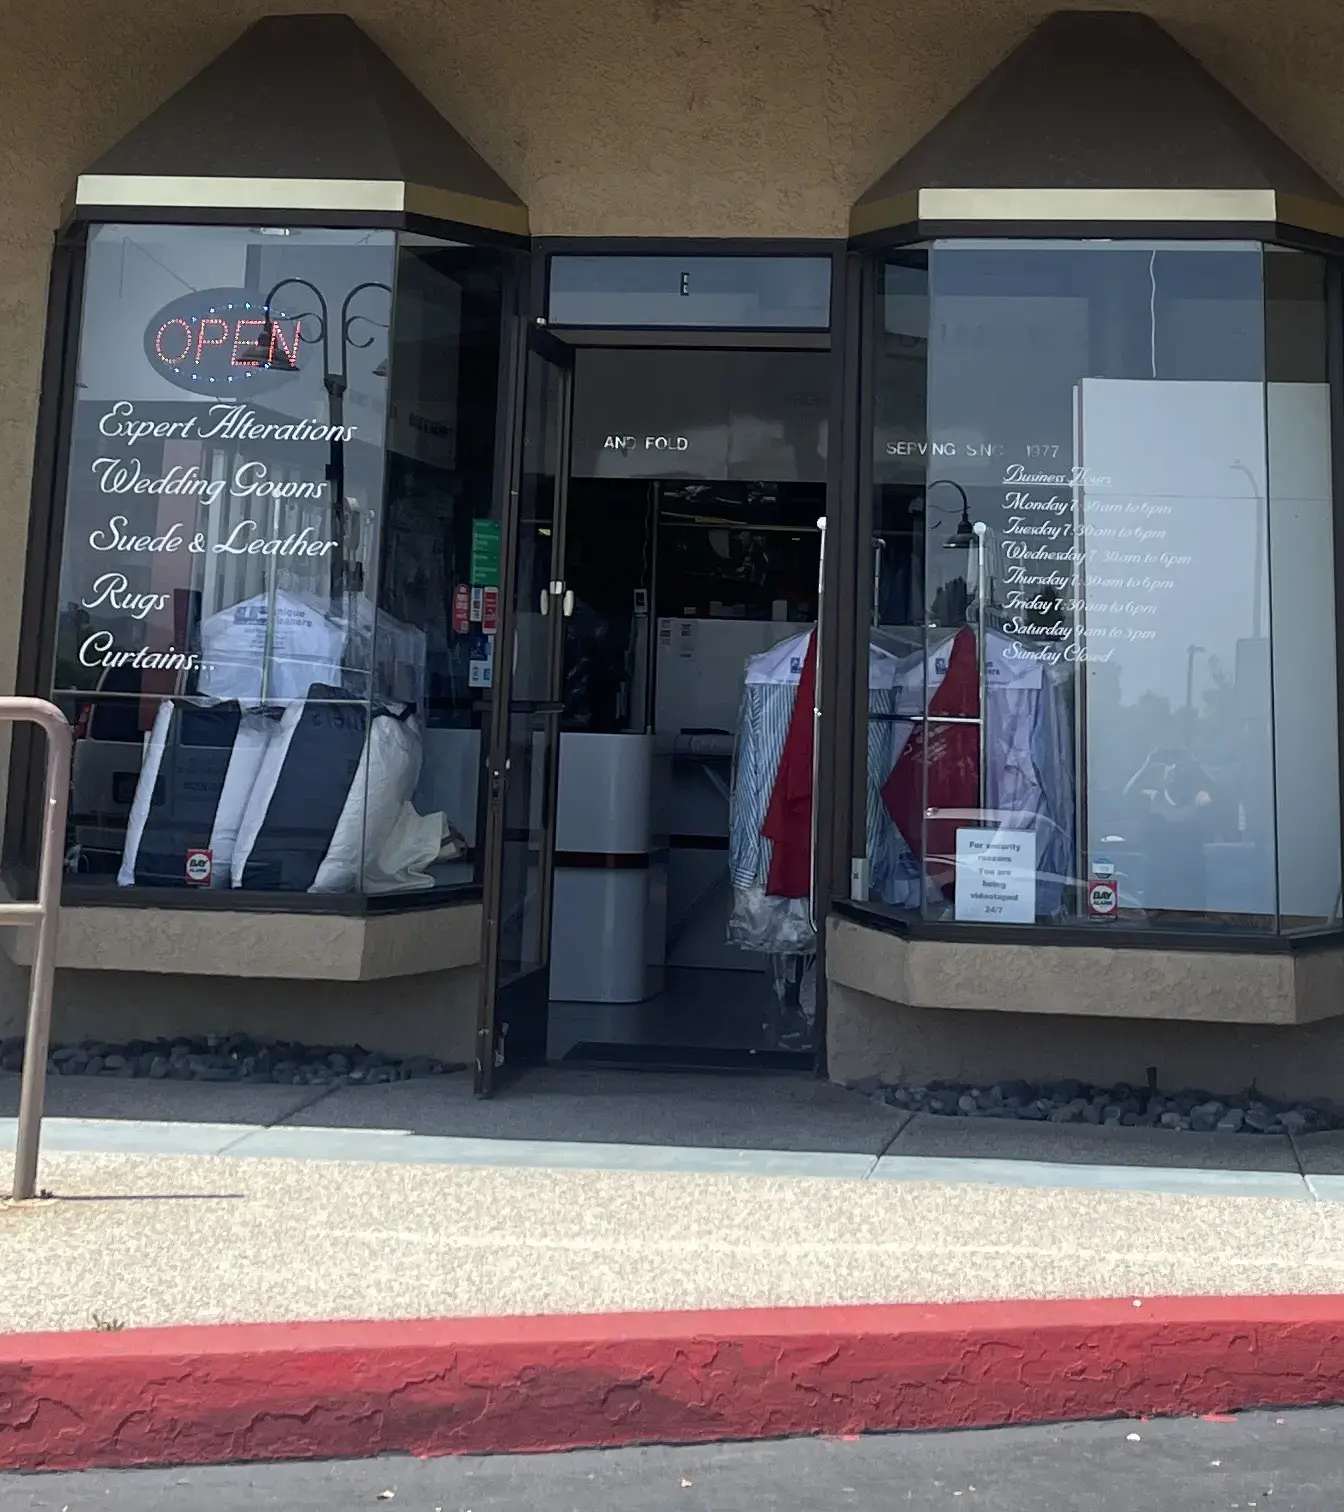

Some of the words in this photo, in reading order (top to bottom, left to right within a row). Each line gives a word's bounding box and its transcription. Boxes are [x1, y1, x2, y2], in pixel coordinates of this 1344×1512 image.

[156, 318, 302, 368] OPEN
[98, 401, 199, 446] Expert
[197, 404, 358, 442] Alterations
[603, 435, 636, 449] AND
[645, 436, 689, 450] FOLD
[1025, 444, 1061, 458] 1977
[91, 457, 227, 505] Wedding
[229, 461, 328, 499] Gowns
[1002, 464, 1067, 484] Business
[1001, 491, 1069, 516] Monday
[89, 515, 185, 552] Suede
[188, 532, 206, 553] &
[212, 520, 339, 556] Leather
[1002, 516, 1062, 540] Tuesday
[1001, 540, 1086, 566] Wednesday
[1002, 566, 1070, 591] Thursday
[81, 572, 171, 620] Rugs
[1002, 590, 1054, 615] Friday
[1002, 616, 1073, 641] Saturday
[79, 630, 215, 671] Curtains...
[1002, 640, 1062, 666] Sunday
[1063, 643, 1116, 663] Closed
